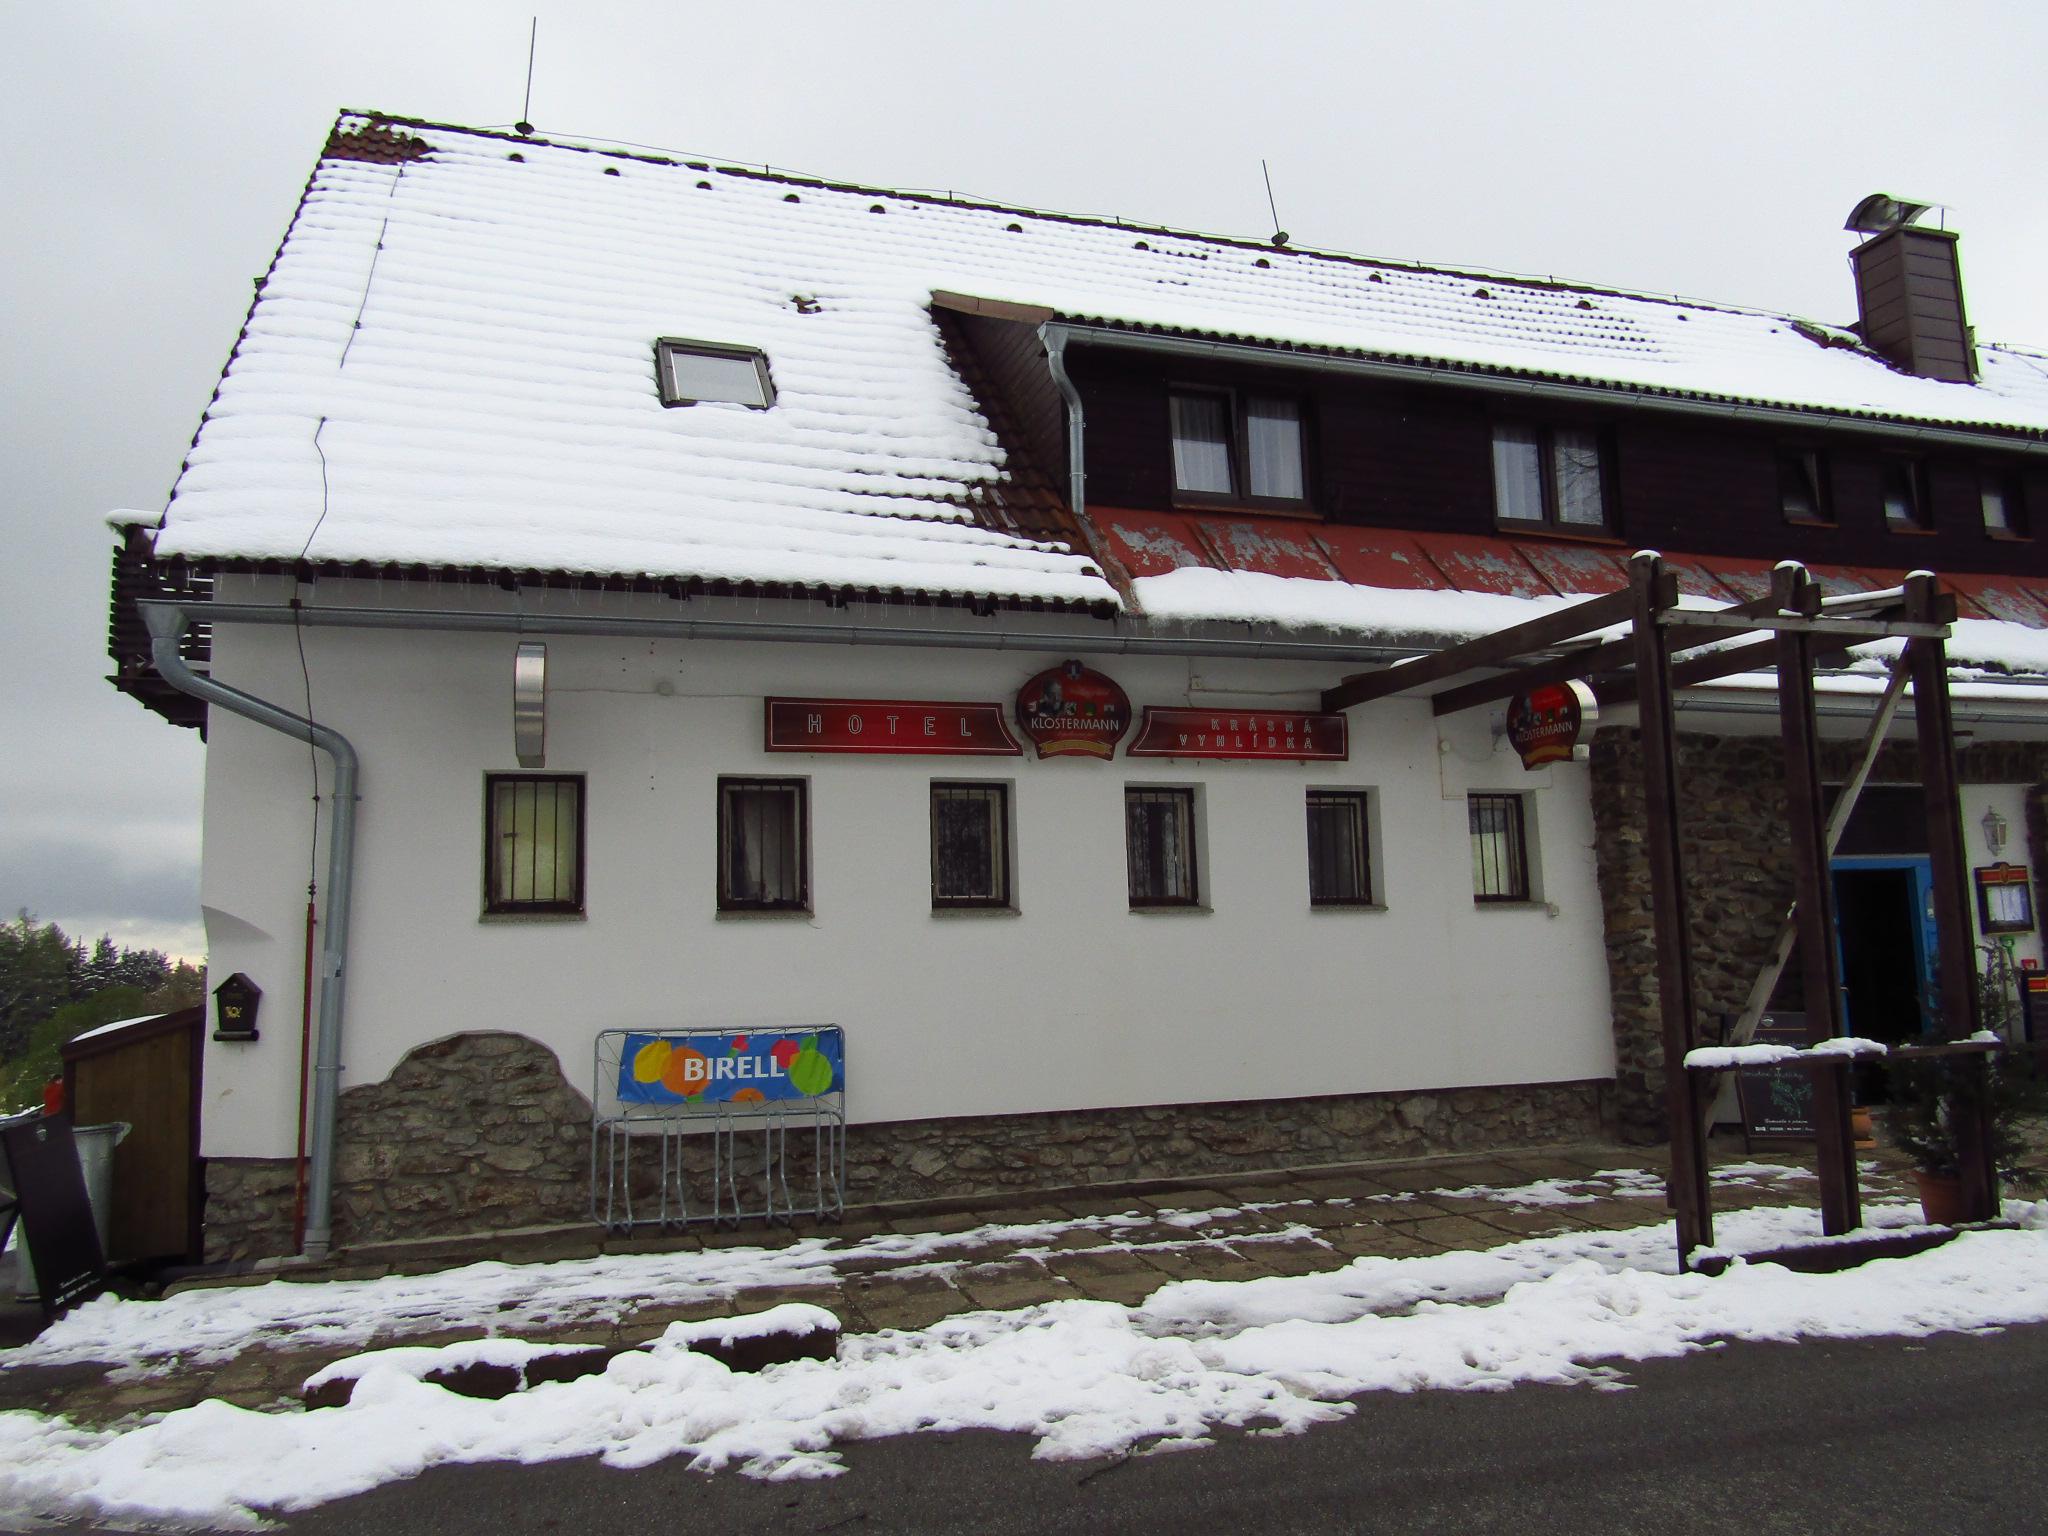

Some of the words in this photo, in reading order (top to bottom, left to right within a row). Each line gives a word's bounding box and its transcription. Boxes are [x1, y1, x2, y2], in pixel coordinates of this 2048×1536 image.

[808, 713, 972, 737] HOTEL
[1031, 717, 1119, 731] KLOSTERMANN
[1211, 717, 1312, 734] KRÁSNÁ
[1515, 721, 1573, 744] OSTERMANN
[1179, 733, 1313, 749] VYHLÍDKA
[684, 1055, 785, 1081] BIRELL
